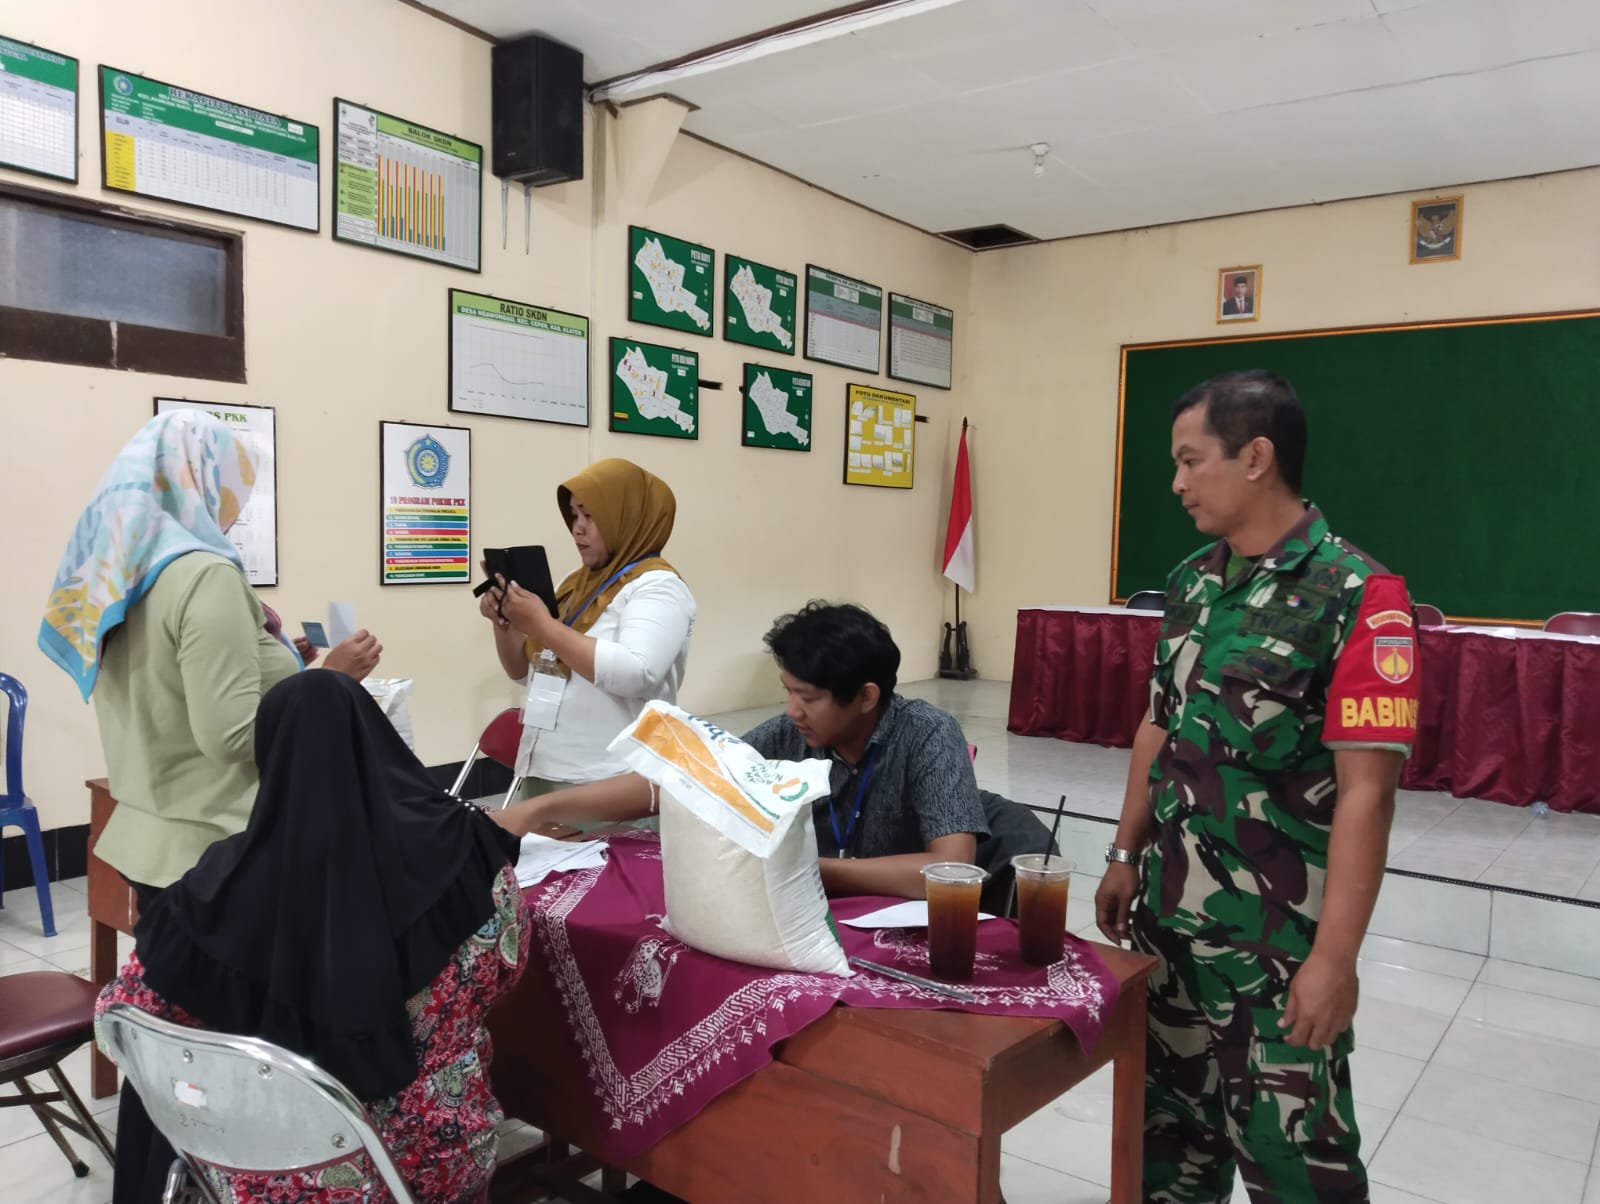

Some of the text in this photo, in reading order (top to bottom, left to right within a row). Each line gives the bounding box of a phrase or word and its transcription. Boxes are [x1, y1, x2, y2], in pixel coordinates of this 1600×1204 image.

[500, 303, 548, 321] RATIO SKDN
[224, 412, 248, 423] PKK
